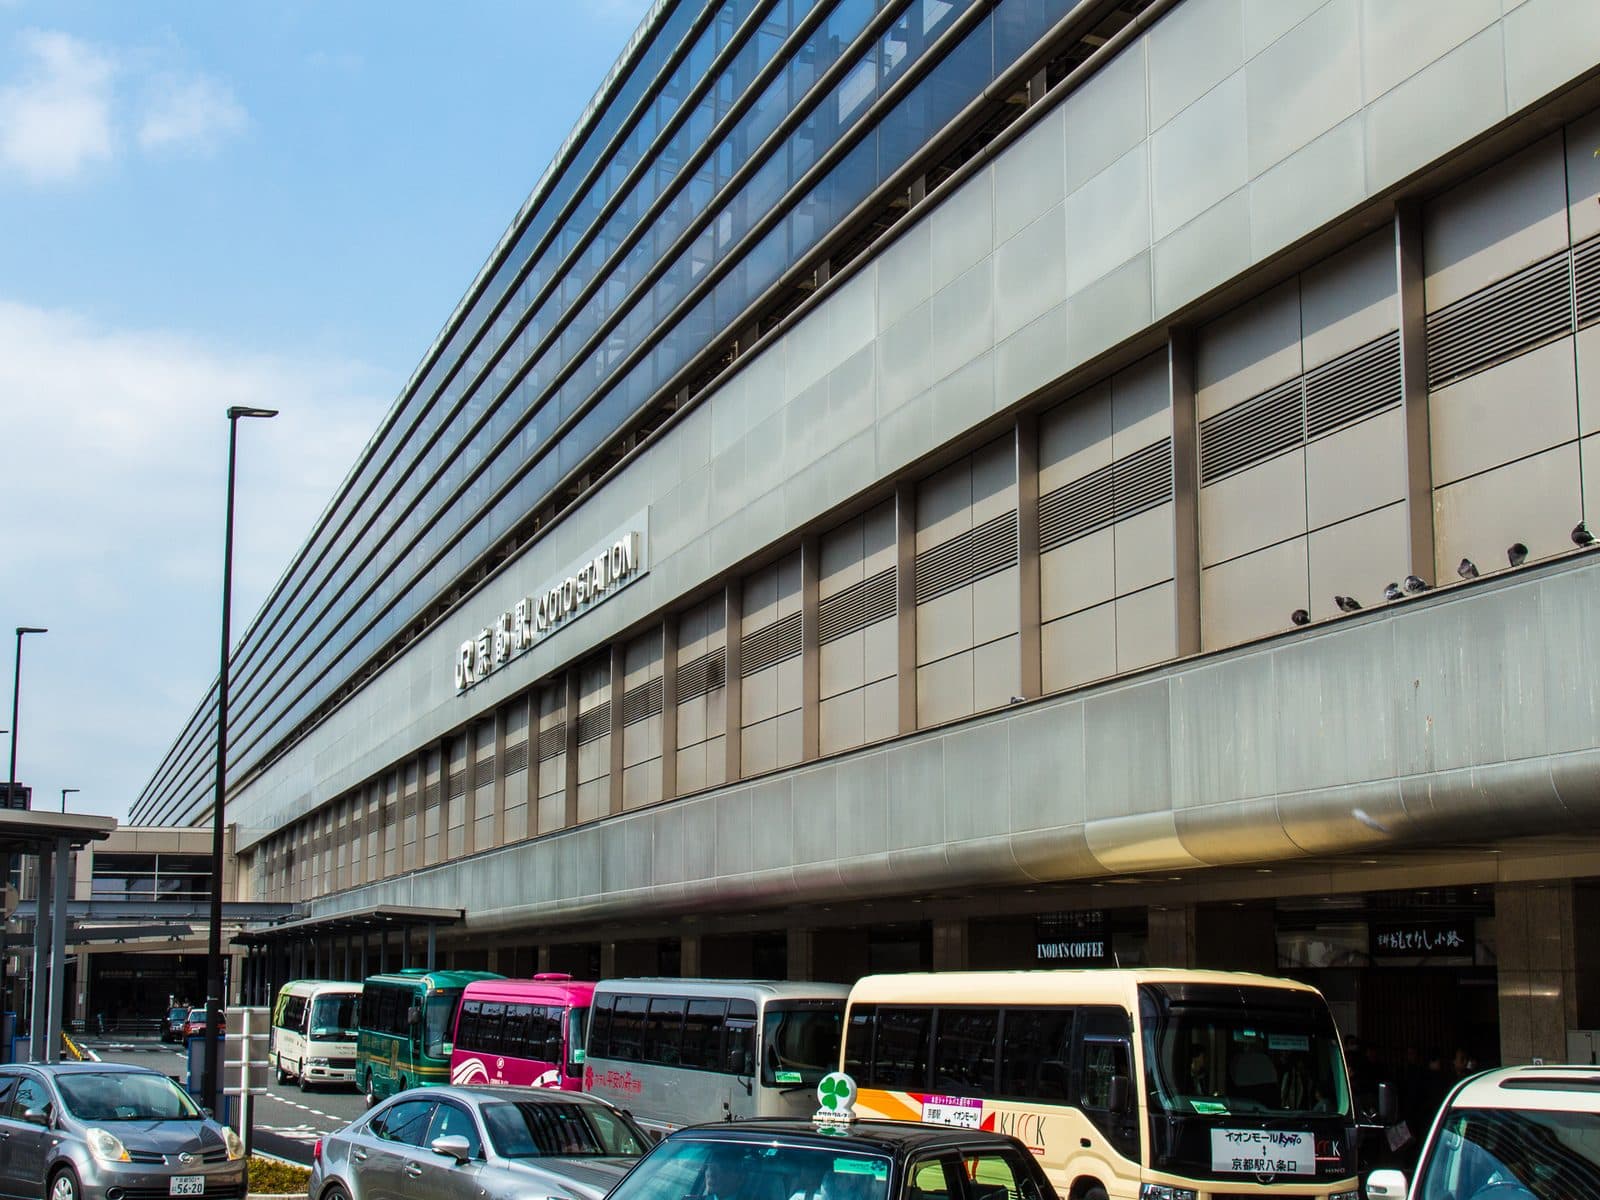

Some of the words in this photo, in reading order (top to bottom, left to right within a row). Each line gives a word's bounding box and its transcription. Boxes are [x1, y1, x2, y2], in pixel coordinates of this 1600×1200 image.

[535, 577, 577, 632] KYOTO
[576, 531, 640, 603] STATION
[1037, 942, 1069, 959] INODA'S
[1070, 941, 1104, 958] COFFEE
[952, 1111, 978, 1122] イオンモール
[1231, 1158, 1297, 1172] 京都駅八条口
